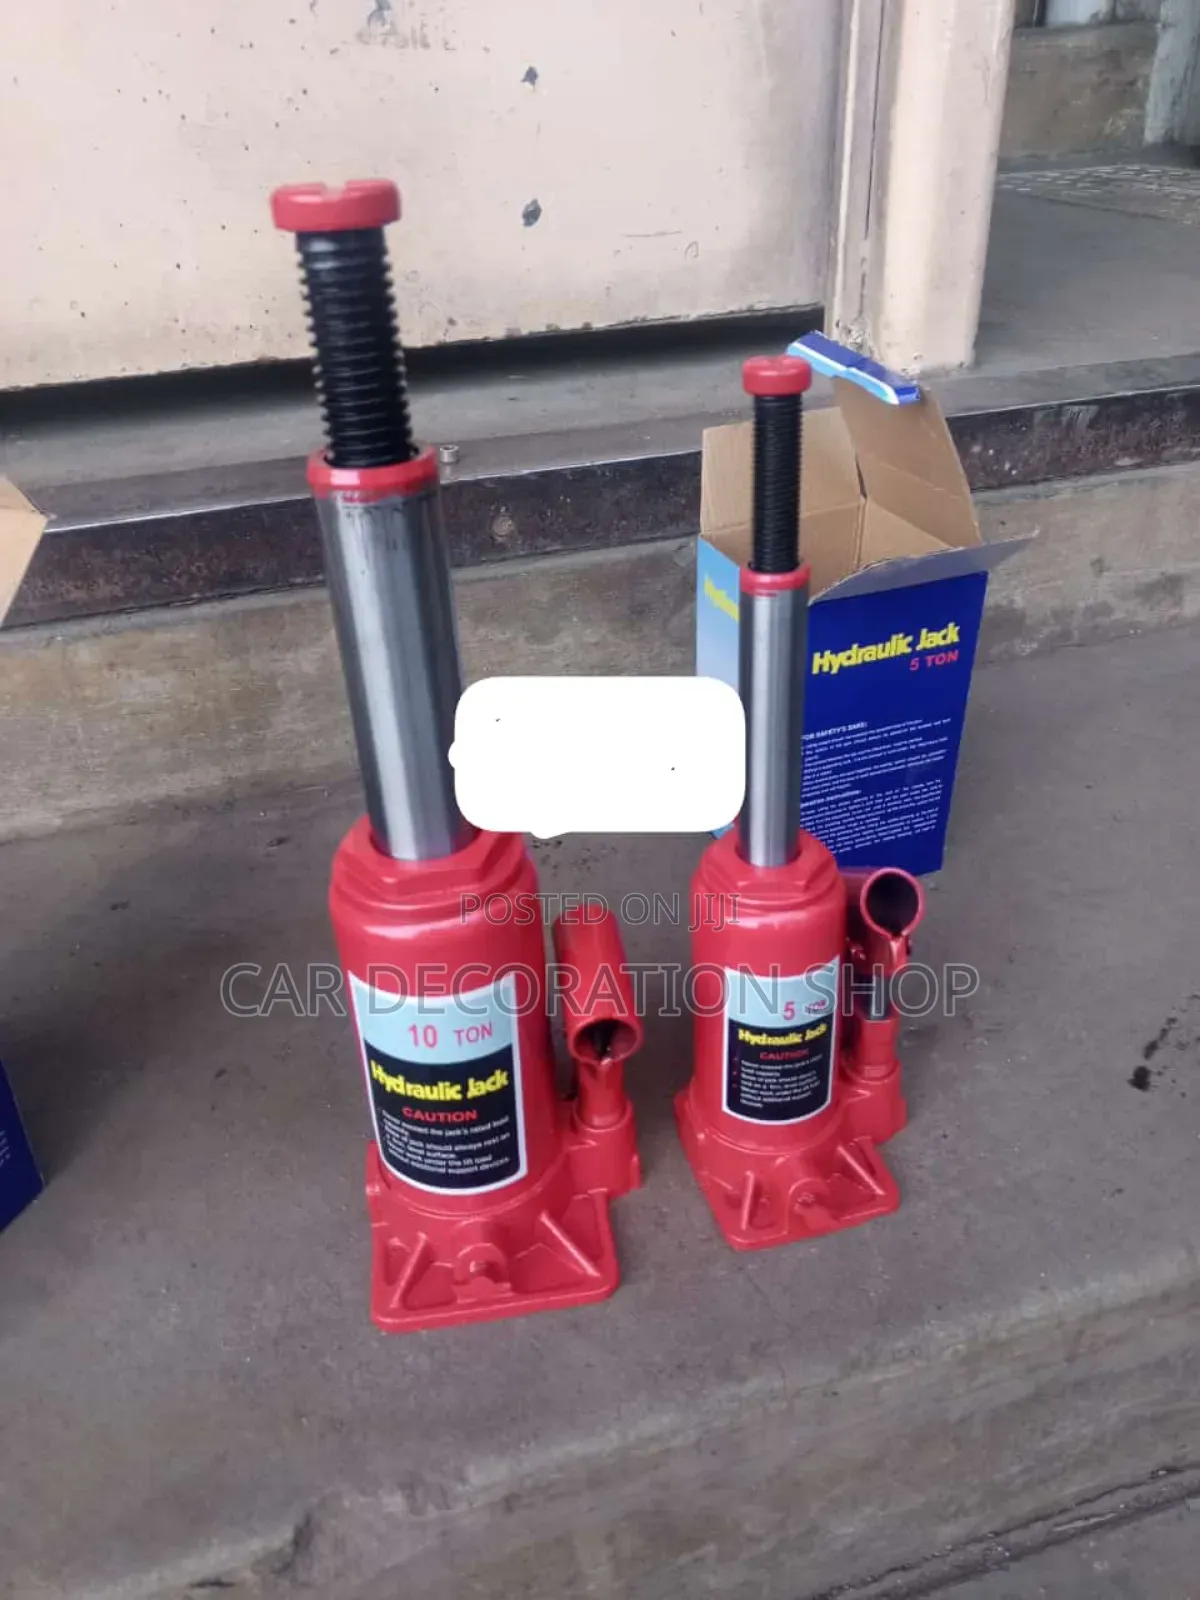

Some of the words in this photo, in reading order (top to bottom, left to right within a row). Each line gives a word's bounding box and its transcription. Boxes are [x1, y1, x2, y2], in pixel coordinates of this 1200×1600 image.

[812, 633, 913, 675] Hydraulic
[916, 622, 961, 651] Jack
[909, 657, 920, 671] 5
[925, 649, 960, 667] TON
[784, 1000, 796, 1021] 5
[409, 1024, 438, 1048] 10
[453, 1020, 493, 1047] TON
[738, 1028, 803, 1046] Hydraulic
[370, 1060, 464, 1101] Hydraulic
[467, 1068, 509, 1099] Jack
[402, 1106, 477, 1123] CAUTION
